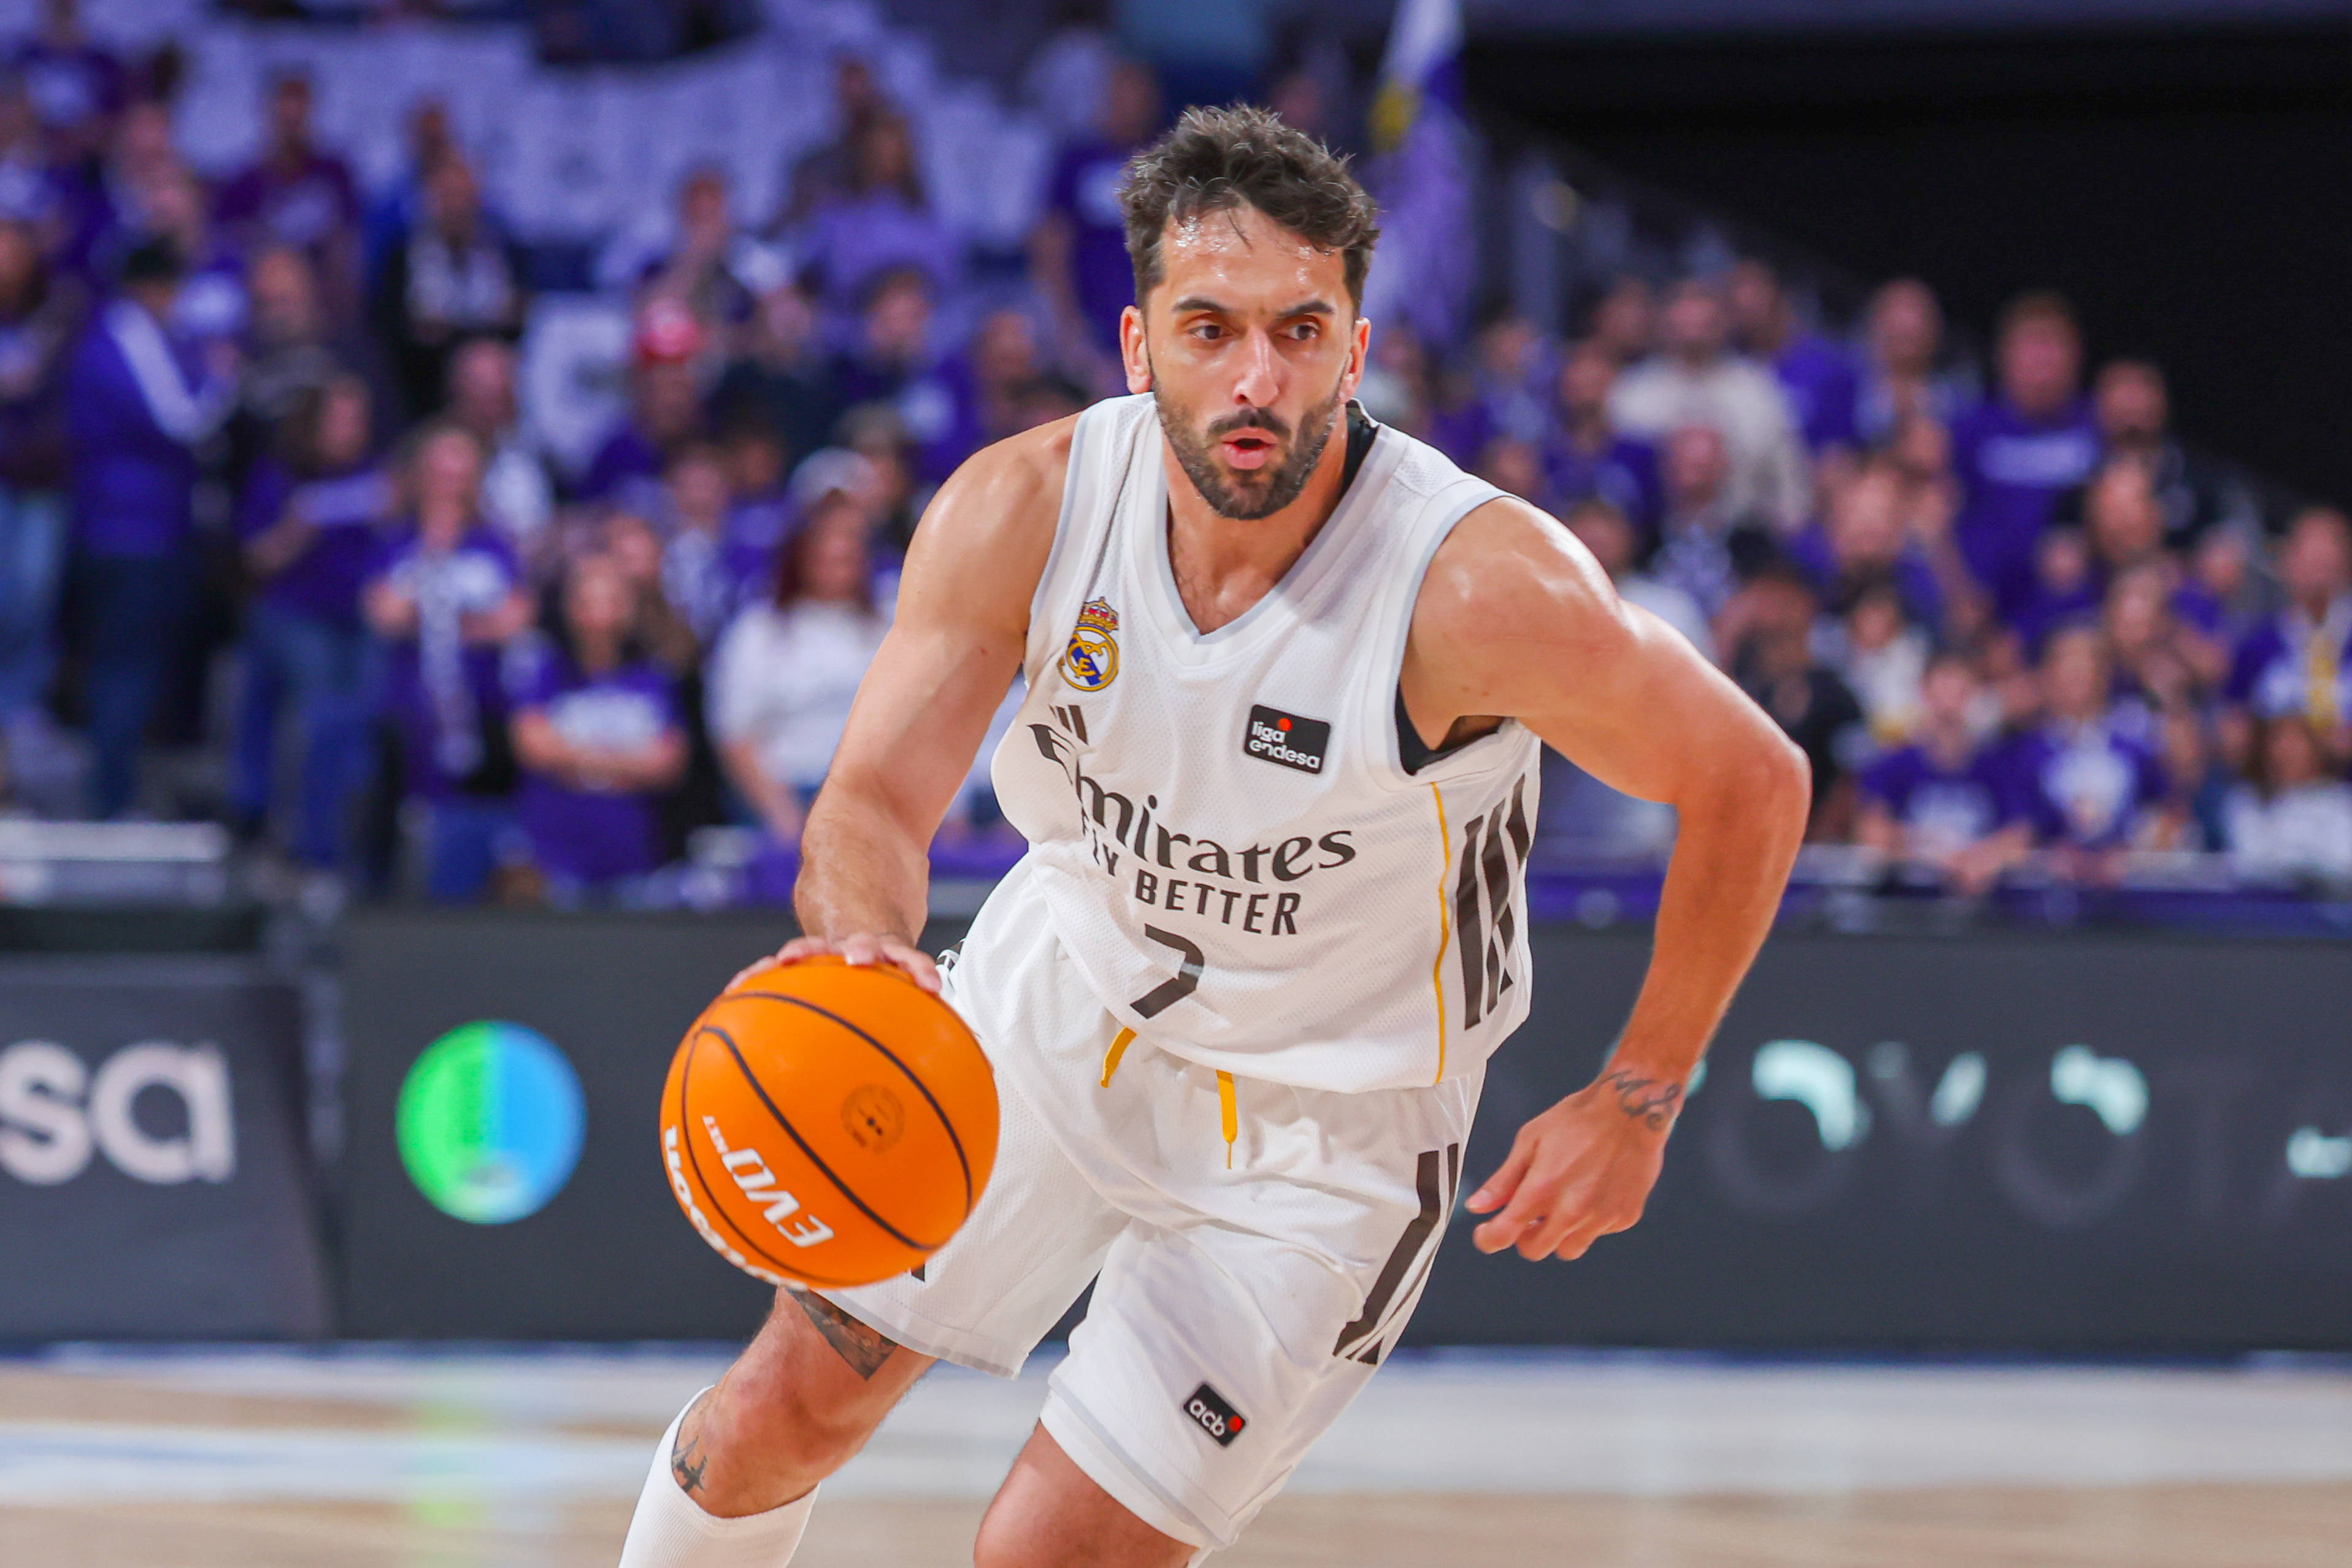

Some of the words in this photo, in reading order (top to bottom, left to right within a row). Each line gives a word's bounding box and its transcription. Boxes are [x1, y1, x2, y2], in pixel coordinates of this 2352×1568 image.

[1249, 739, 1321, 769] endesa
[1251, 721, 1286, 744] liga
[1026, 723, 1356, 884] Emirates
[1135, 868, 1301, 936] BETTER
[1129, 923, 1205, 1020] 7
[721, 1148, 834, 1248] EVO
[1189, 1399, 1226, 1437] acb
